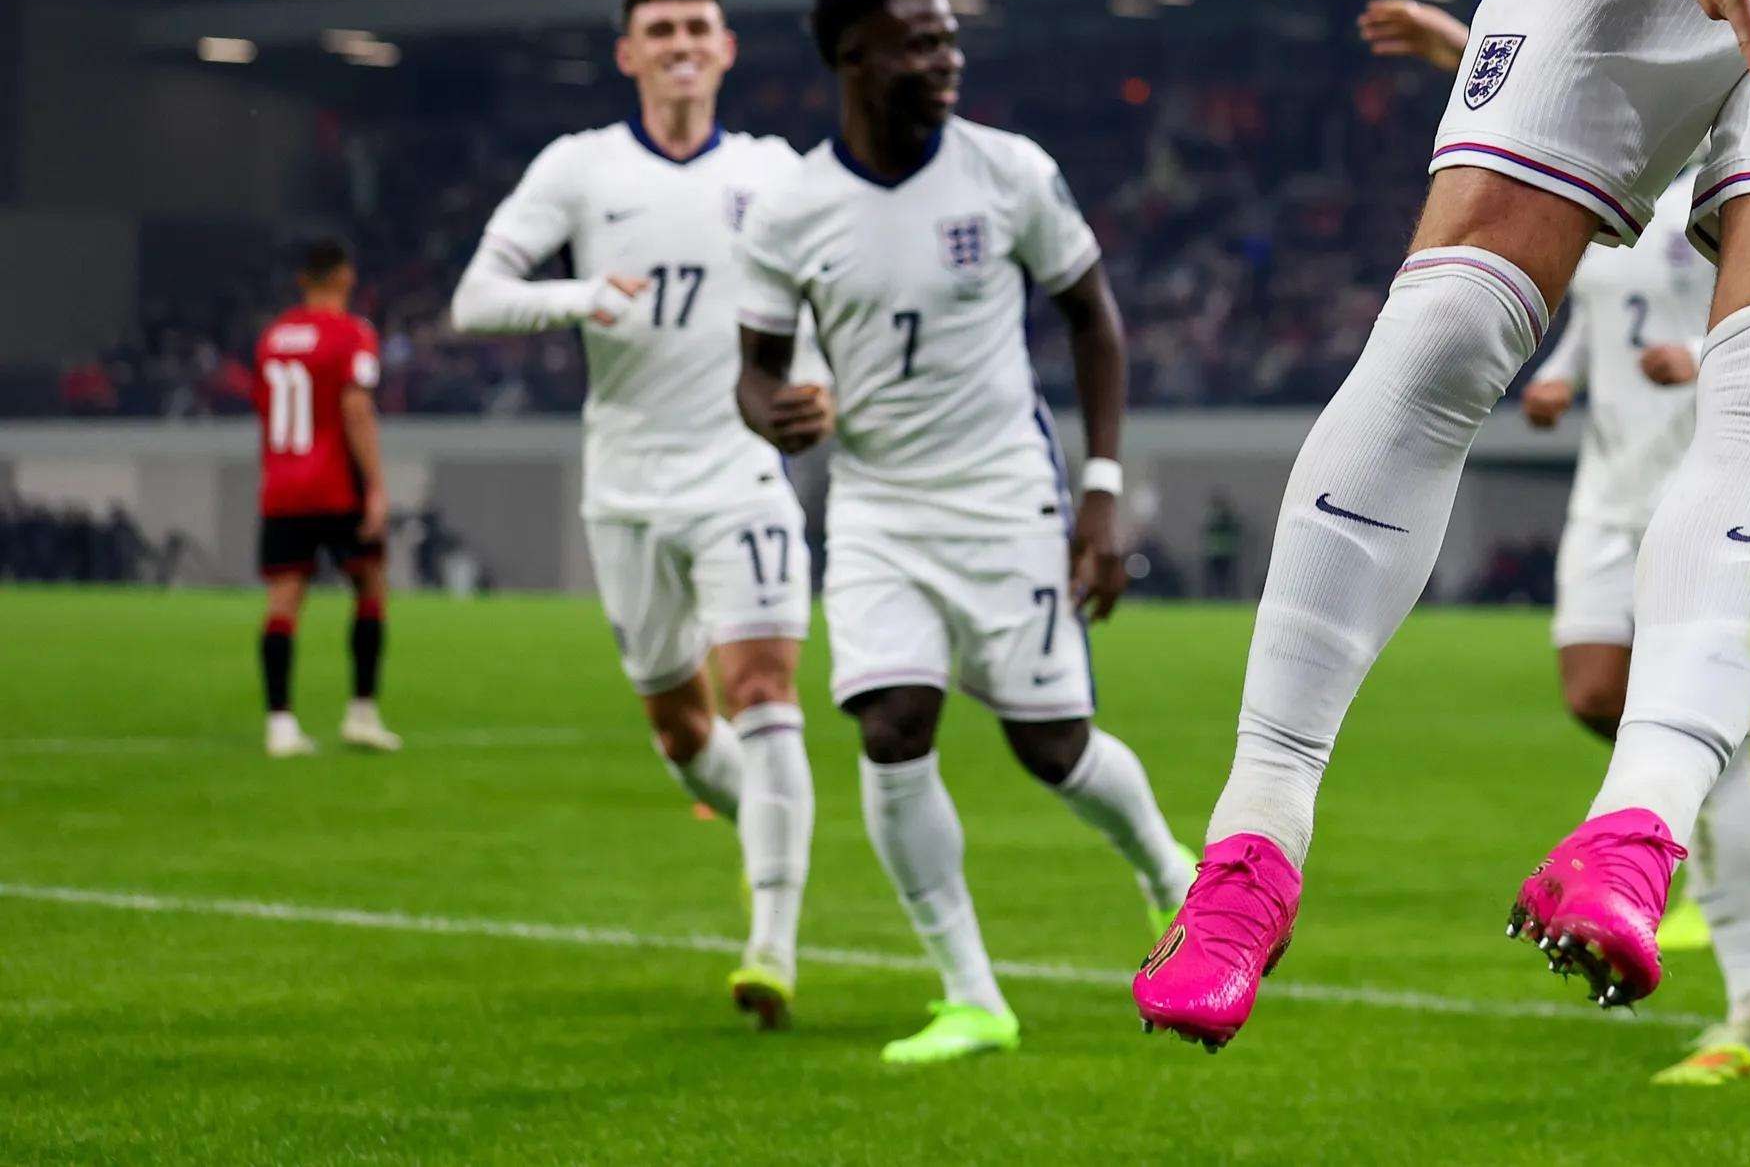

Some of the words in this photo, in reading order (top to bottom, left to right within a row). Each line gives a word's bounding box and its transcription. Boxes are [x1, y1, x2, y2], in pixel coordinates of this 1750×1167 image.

[649, 265, 705, 329] 17
[894, 310, 922, 379] 7
[263, 358, 315, 456] 11
[739, 526, 790, 585] 17
[1033, 588, 1059, 655] 7
